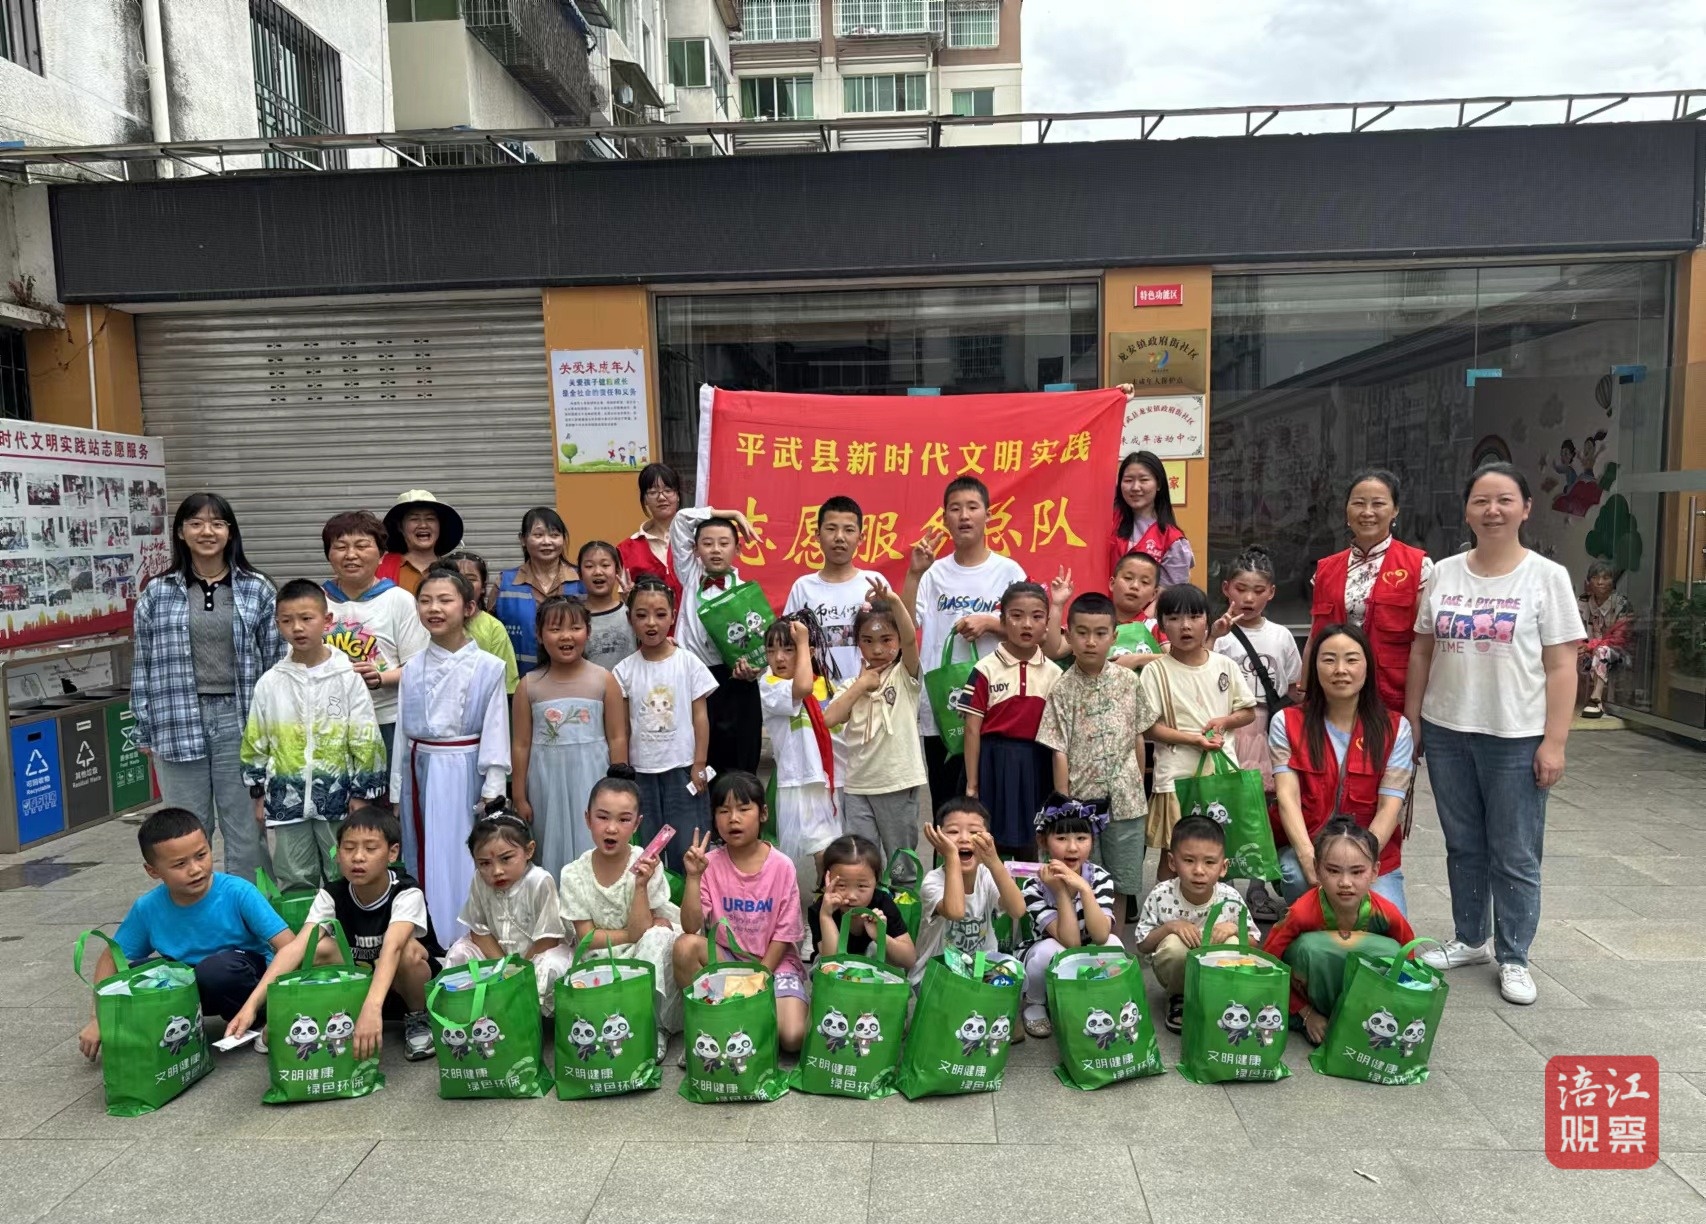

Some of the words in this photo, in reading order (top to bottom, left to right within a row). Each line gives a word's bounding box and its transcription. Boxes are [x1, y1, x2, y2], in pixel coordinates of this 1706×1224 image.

[1140, 289, 1178, 301] 特色功能区
[1118, 335, 1200, 363] 龙安镇政府街社区
[559, 360, 637, 375] 关爱未成年人
[569, 377, 629, 387] 关爱孩子健康成长
[562, 387, 638, 398] 是全社会的责任和义务
[1123, 404, 1195, 427] 武县龙安镇政府街社区
[0, 428, 149, 461] 时代文明实践站志愿服务
[736, 430, 1092, 477] 平武县新时代文明实践
[1168, 475, 1180, 490] 家
[1440, 594, 1464, 607] TAKE
[1464, 598, 1473, 609] A
[1475, 597, 1522, 610] PICTURE
[324, 630, 377, 661] ANG!
[1436, 640, 1465, 654] TIME
[722, 896, 774, 912] URBAN
[805, 1055, 857, 1077] 文明健康
[1081, 1052, 1134, 1071] 文明健康
[1207, 1050, 1262, 1067] 文明健康
[1342, 1045, 1399, 1075] 文明健康
[278, 1066, 334, 1082] 文明健康
[440, 1067, 488, 1080] 文明健康
[564, 1065, 614, 1080] 文明健康
[938, 1059, 987, 1078] 文明健康
[306, 1076, 364, 1096] 绿色环保
[467, 1075, 521, 1092] 绿色环保
[589, 1078, 644, 1093] 绿色环保
[691, 1077, 738, 1094] 文明健康
